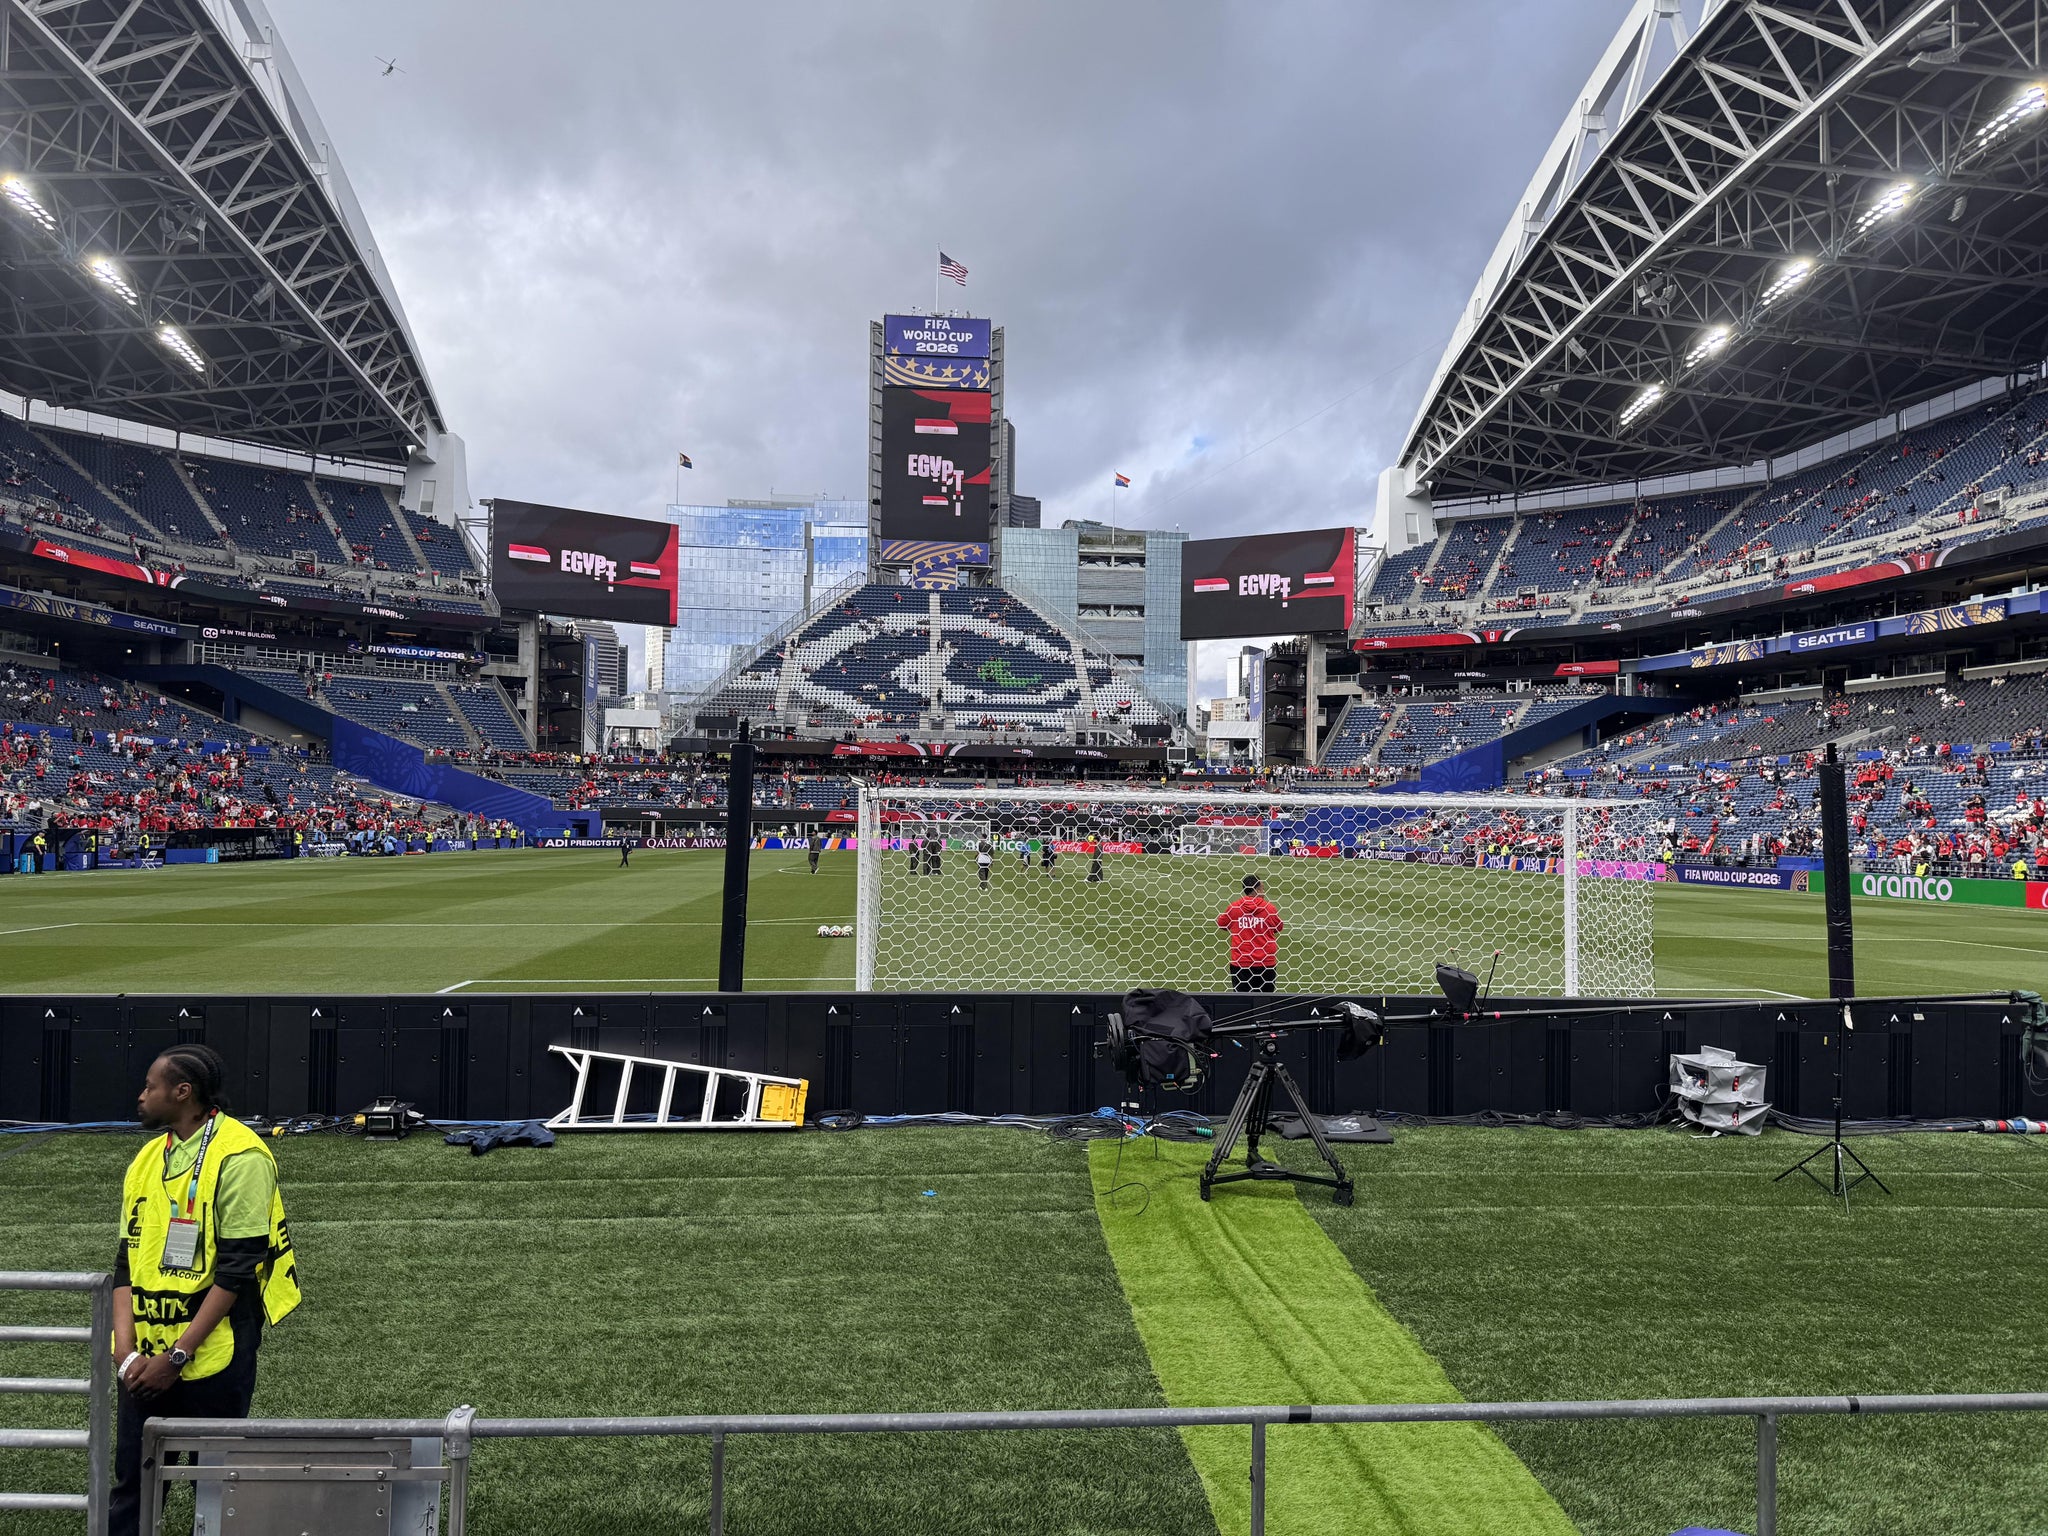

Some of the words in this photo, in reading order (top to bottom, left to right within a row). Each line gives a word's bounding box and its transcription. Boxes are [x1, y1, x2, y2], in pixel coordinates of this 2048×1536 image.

[925, 319, 951, 330] FIFA
[903, 330, 947, 341] WORLD
[949, 332, 973, 342] CUP
[916, 342, 959, 353] 2026
[908, 454, 964, 516] EGYPT
[560, 549, 617, 592] EGYPT
[1239, 574, 1291, 608] EGYPT
[363, 606, 378, 615] FIFA
[133, 620, 177, 634] SEATTLE
[204, 628, 218, 638] CC
[247, 631, 278, 640] BUILDING.
[1798, 627, 1866, 648] SEATTLE
[368, 645, 387, 653] FIFA
[387, 647, 418, 656] WORLD
[418, 649, 436, 657] CUP
[436, 650, 466, 660] 2026
[545, 839, 568, 848] ADI
[646, 838, 687, 849] QATAR
[691, 838, 728, 848] AIRWA
[781, 838, 810, 849] VISA
[1489, 855, 1505, 868] VISA
[1523, 856, 1541, 872] VISA
[1685, 869, 1701, 880] FIFA
[1701, 870, 1730, 882] WORLD
[1731, 872, 1748, 883] CUP
[1748, 872, 1778, 885] 2026
[1862, 874, 1953, 901] aramco
[1238, 917, 1265, 928] EGYPT
[197, 1145, 206, 1164] WORLD
[204, 1118, 214, 1136] 2026
[132, 1294, 191, 1319] URITY
